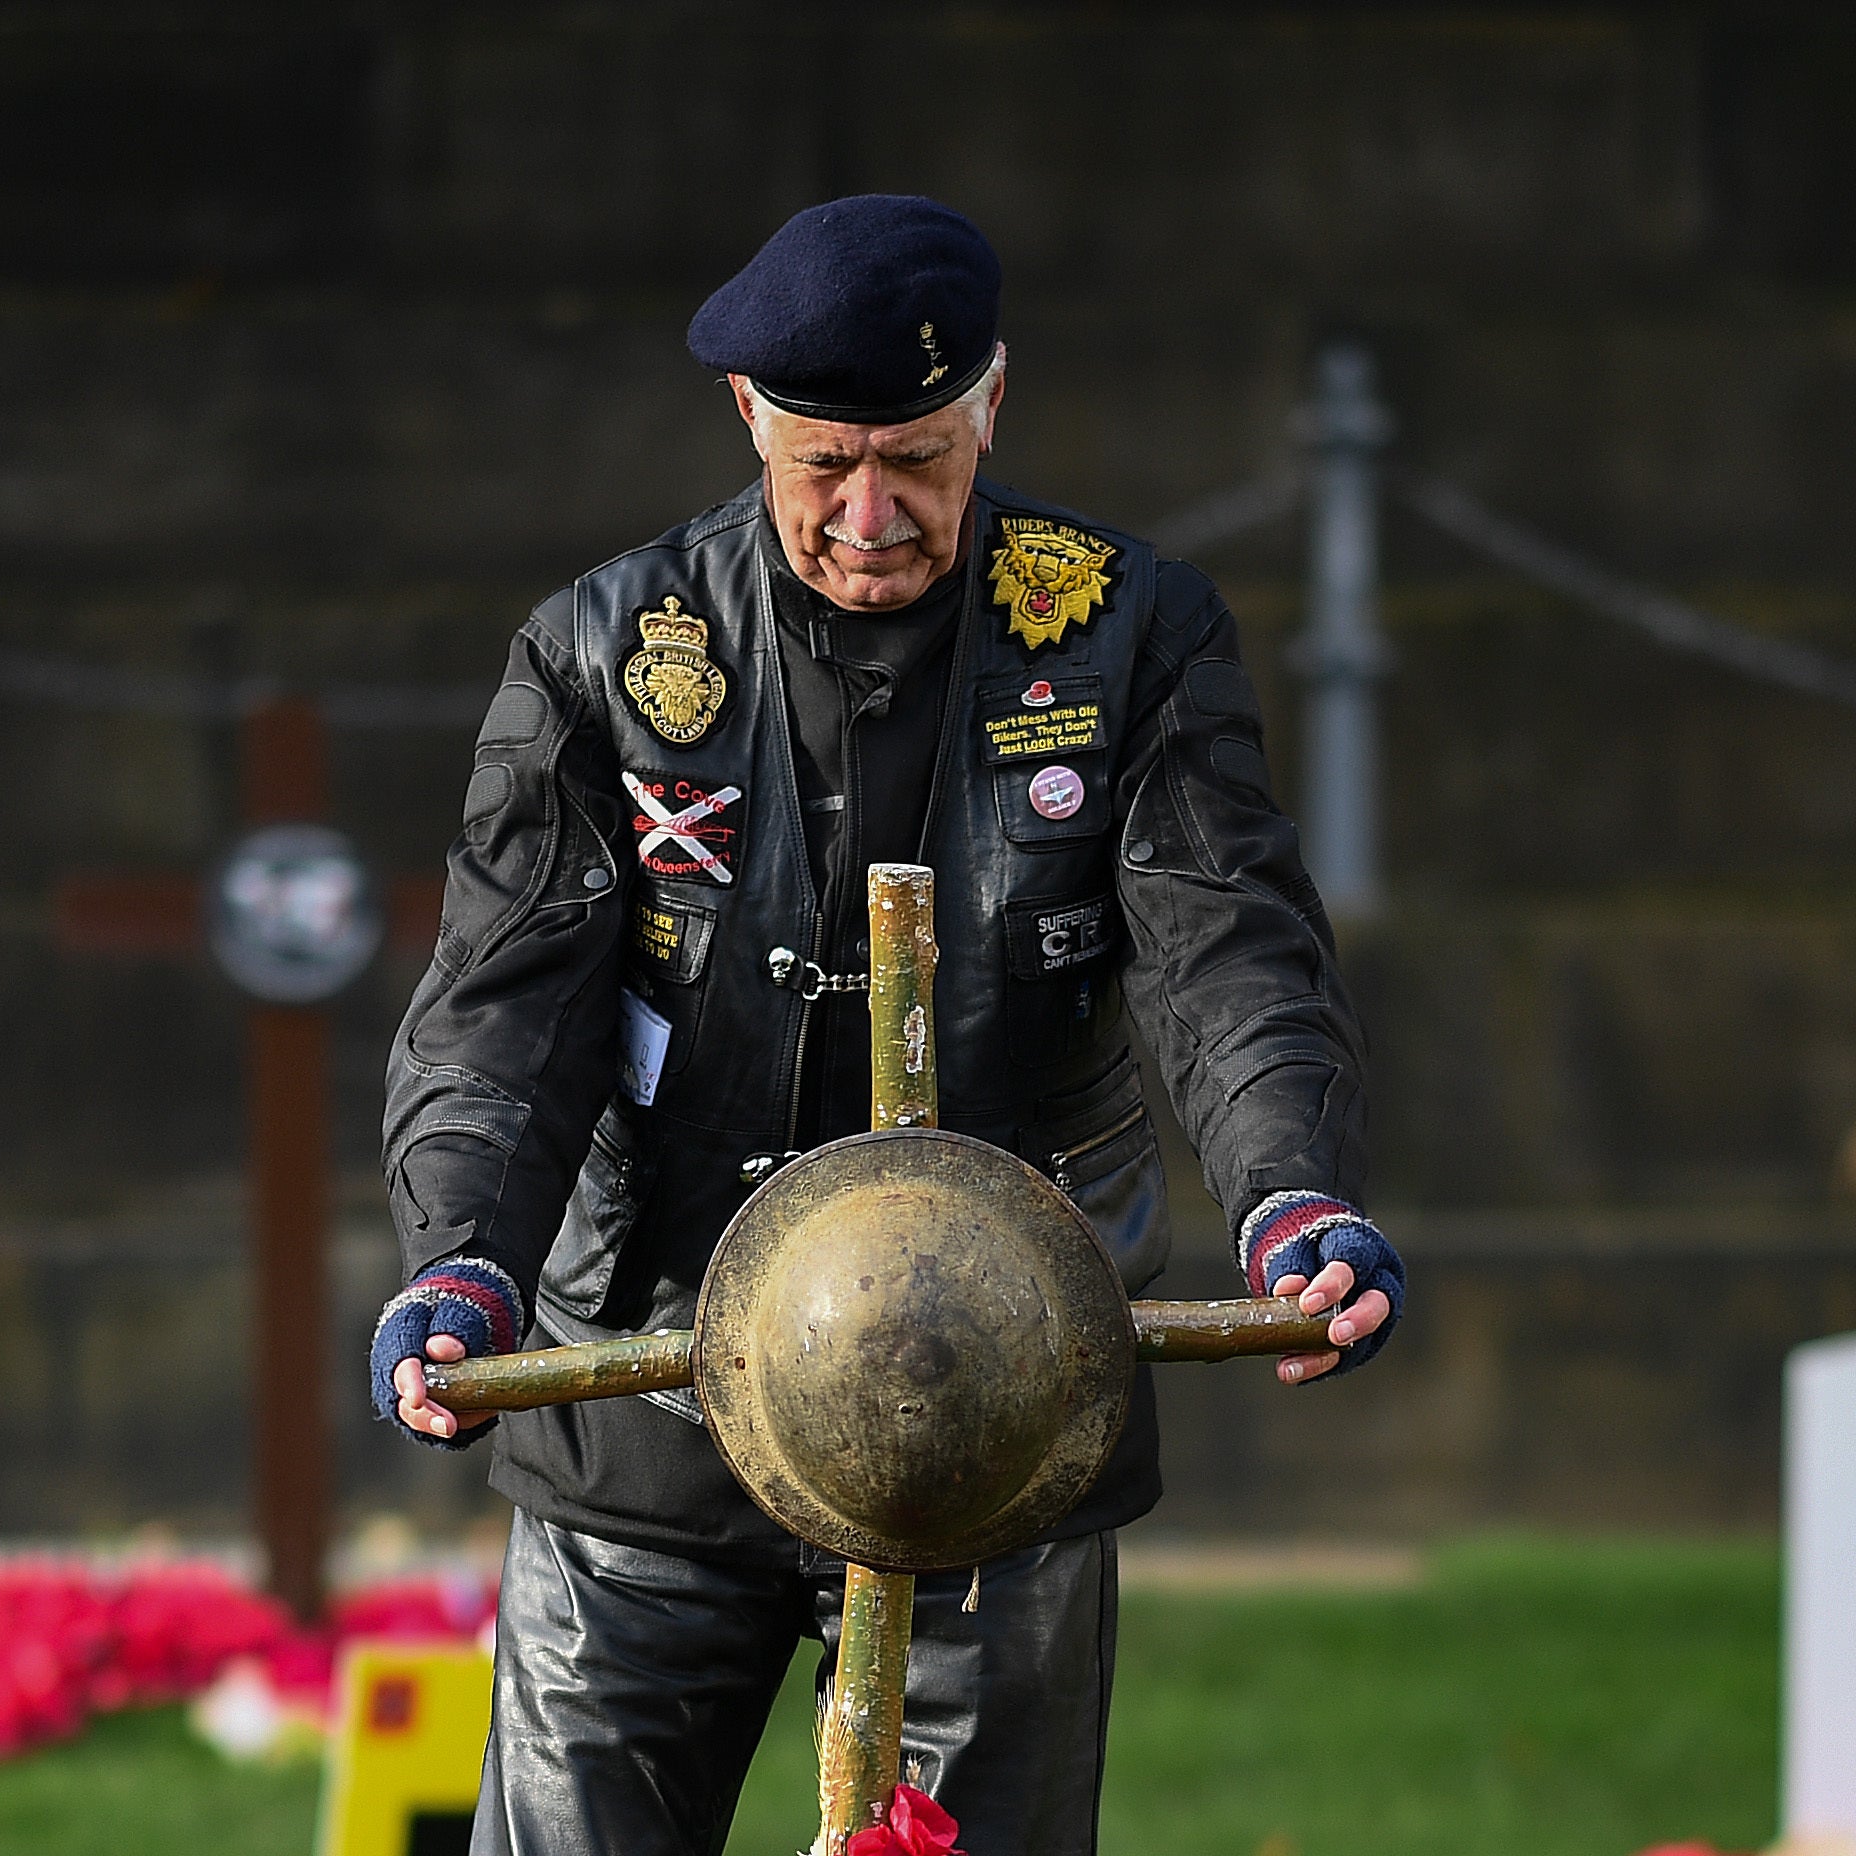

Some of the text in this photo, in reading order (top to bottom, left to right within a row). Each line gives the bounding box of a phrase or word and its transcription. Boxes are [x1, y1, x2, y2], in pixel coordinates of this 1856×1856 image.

[1001, 517, 1117, 557] RIDERS BRANCH
[630, 651, 659, 674] ROYAL
[663, 650, 711, 673] BRITISH
[654, 711, 705, 739] SCOTLAND
[985, 705, 1098, 733] Don't Mess With Old
[1035, 725, 1062, 738] They
[1065, 719, 1097, 733] Don't
[998, 743, 1023, 756] Just
[1024, 737, 1056, 753] LOOK
[1038, 903, 1102, 933] SUFFERING
